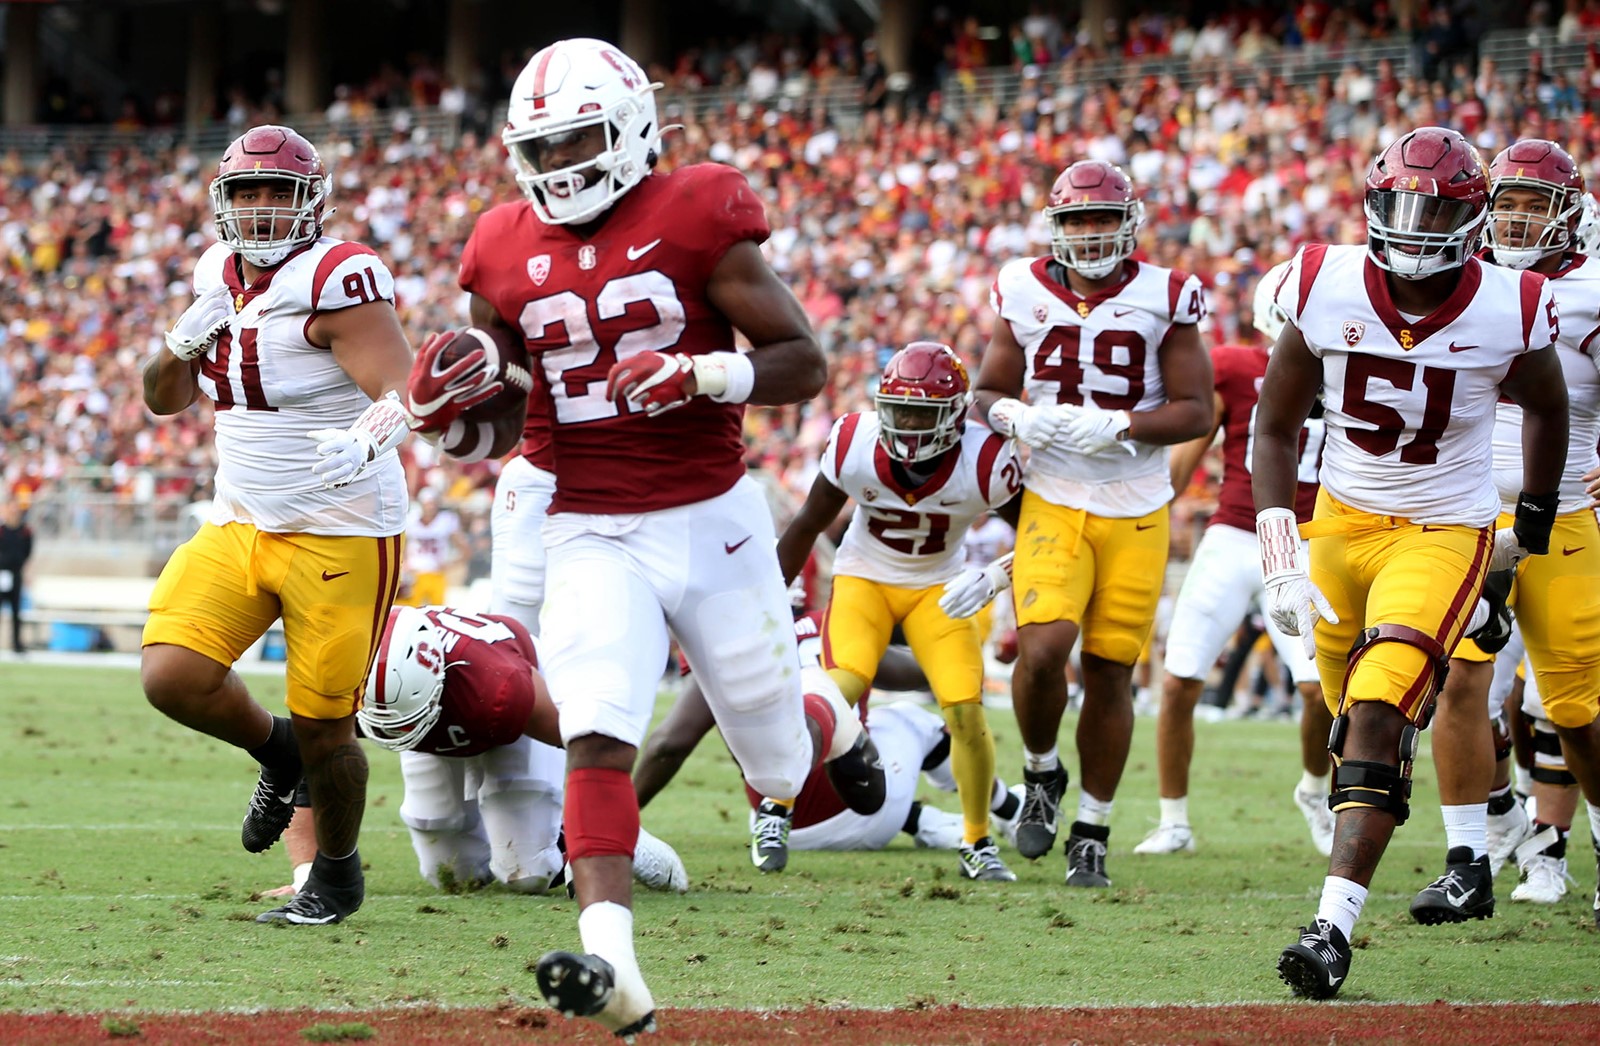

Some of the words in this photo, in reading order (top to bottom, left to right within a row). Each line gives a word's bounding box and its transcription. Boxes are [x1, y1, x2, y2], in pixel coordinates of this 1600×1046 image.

[342, 266, 383, 303] 91
[518, 269, 687, 424] 22
[1346, 332, 1358, 342] 12
[1400, 329, 1413, 349] SC
[199, 327, 279, 412] 91
[1031, 326, 1146, 410] 49
[1342, 353, 1456, 464] 51
[868, 508, 950, 555] 21
[447, 725, 471, 747] C
